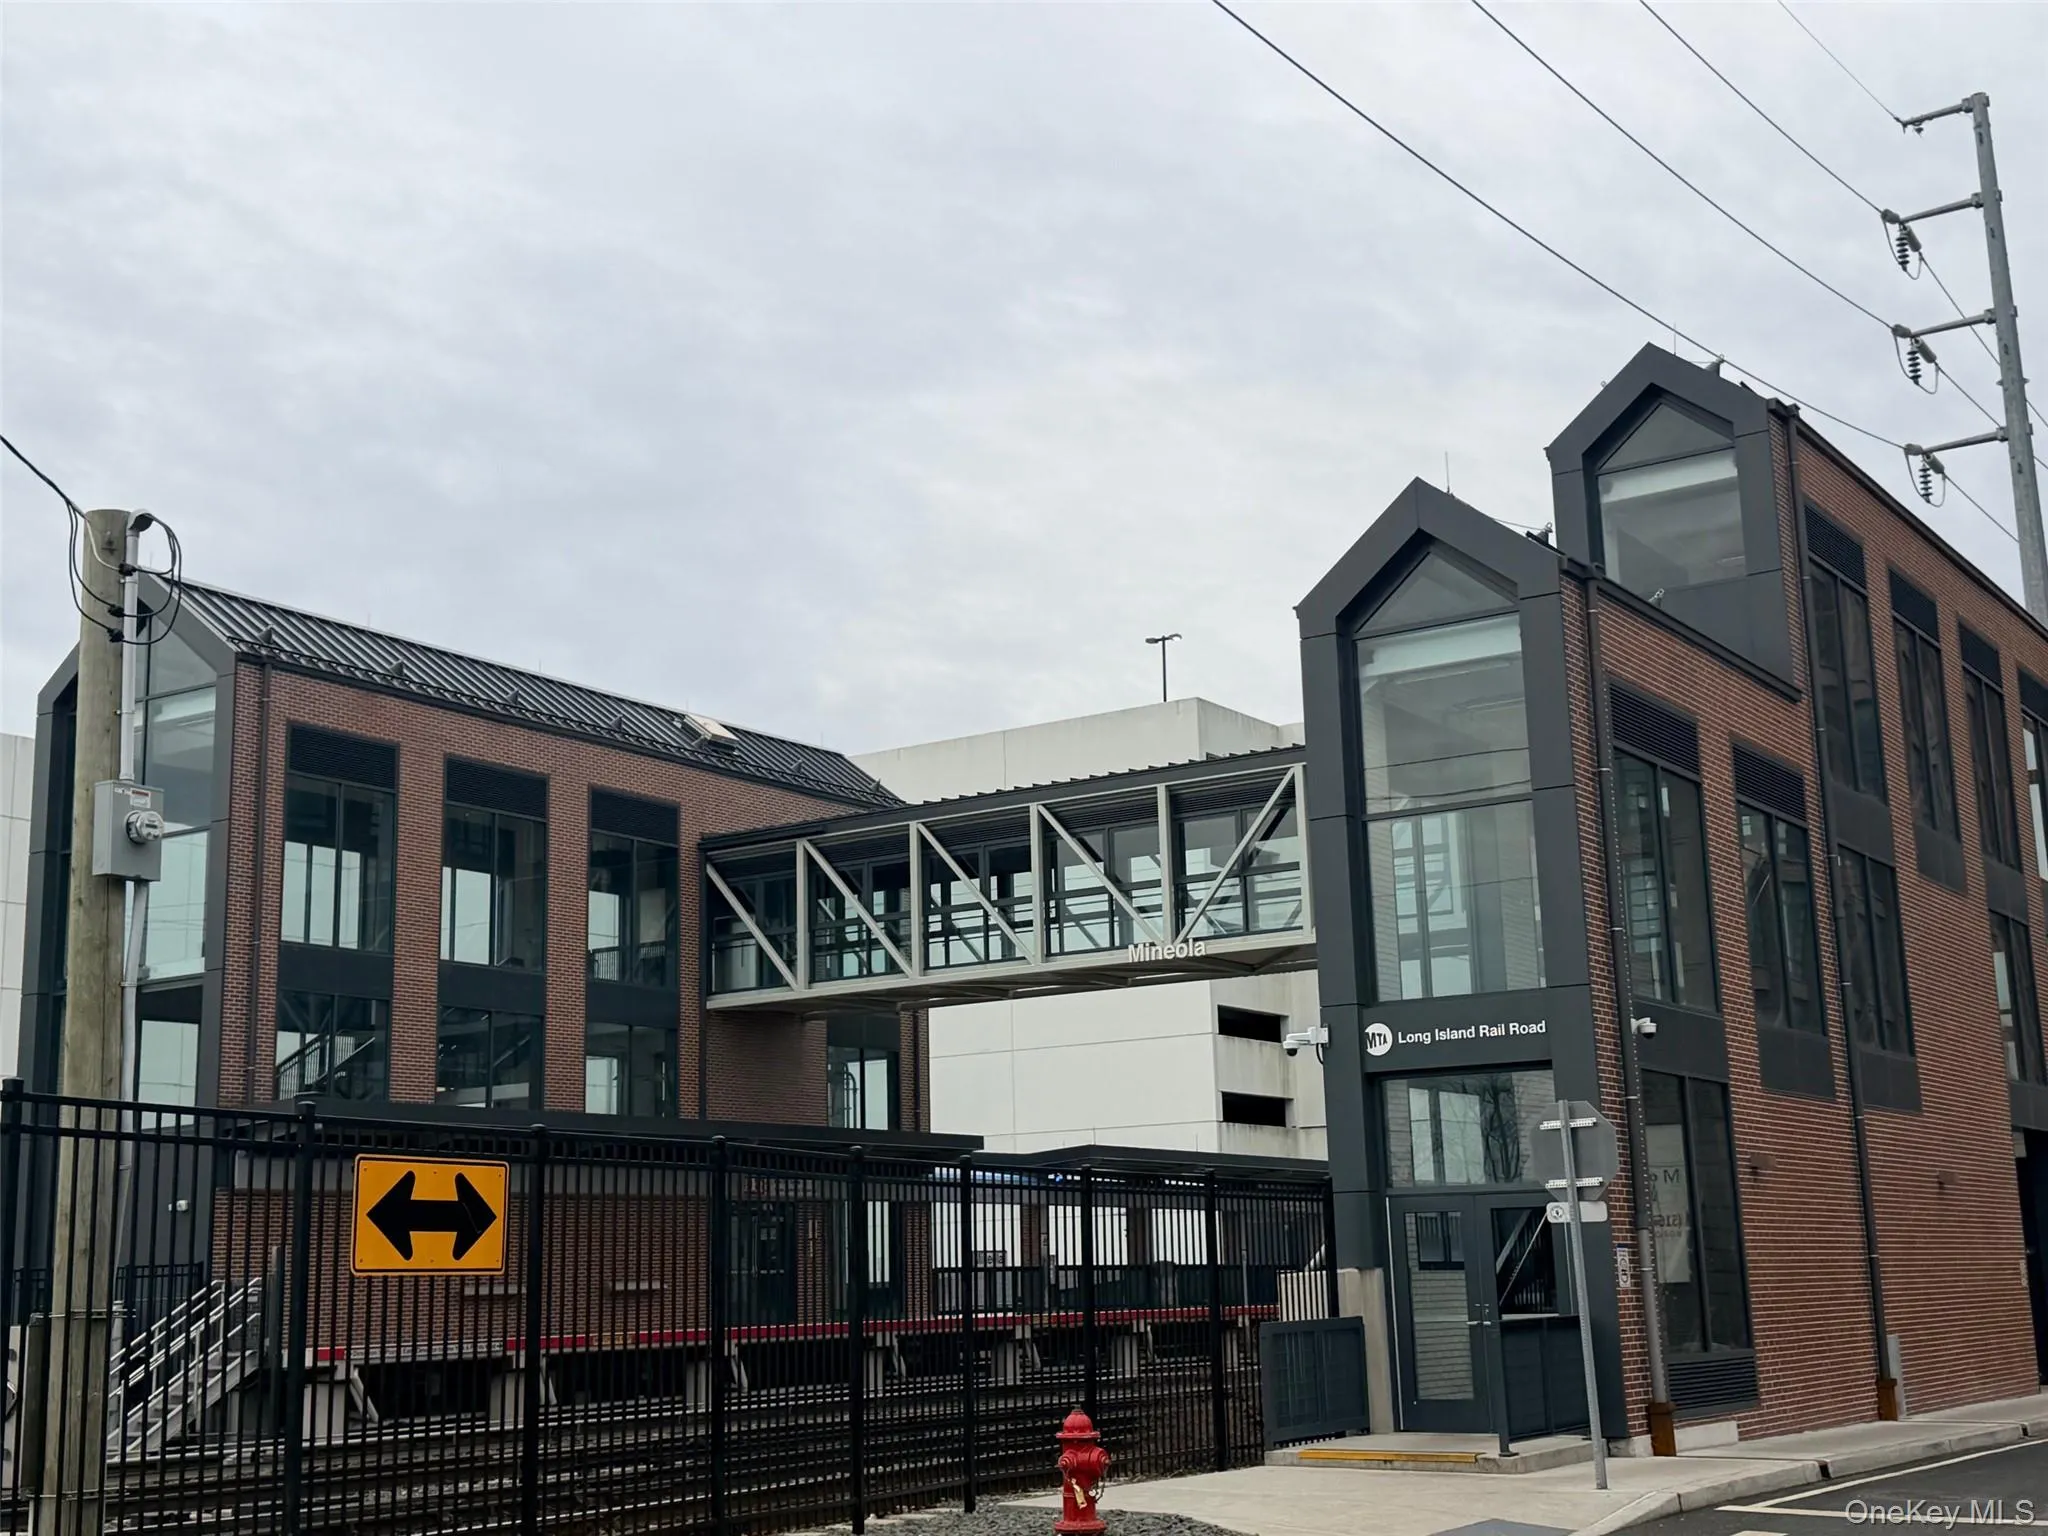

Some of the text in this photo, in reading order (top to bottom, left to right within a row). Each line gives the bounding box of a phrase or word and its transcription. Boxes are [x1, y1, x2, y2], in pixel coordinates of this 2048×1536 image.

[1128, 938, 1206, 962] Mineola
[1365, 1020, 1546, 1051] MTA Long Island Rail Road
